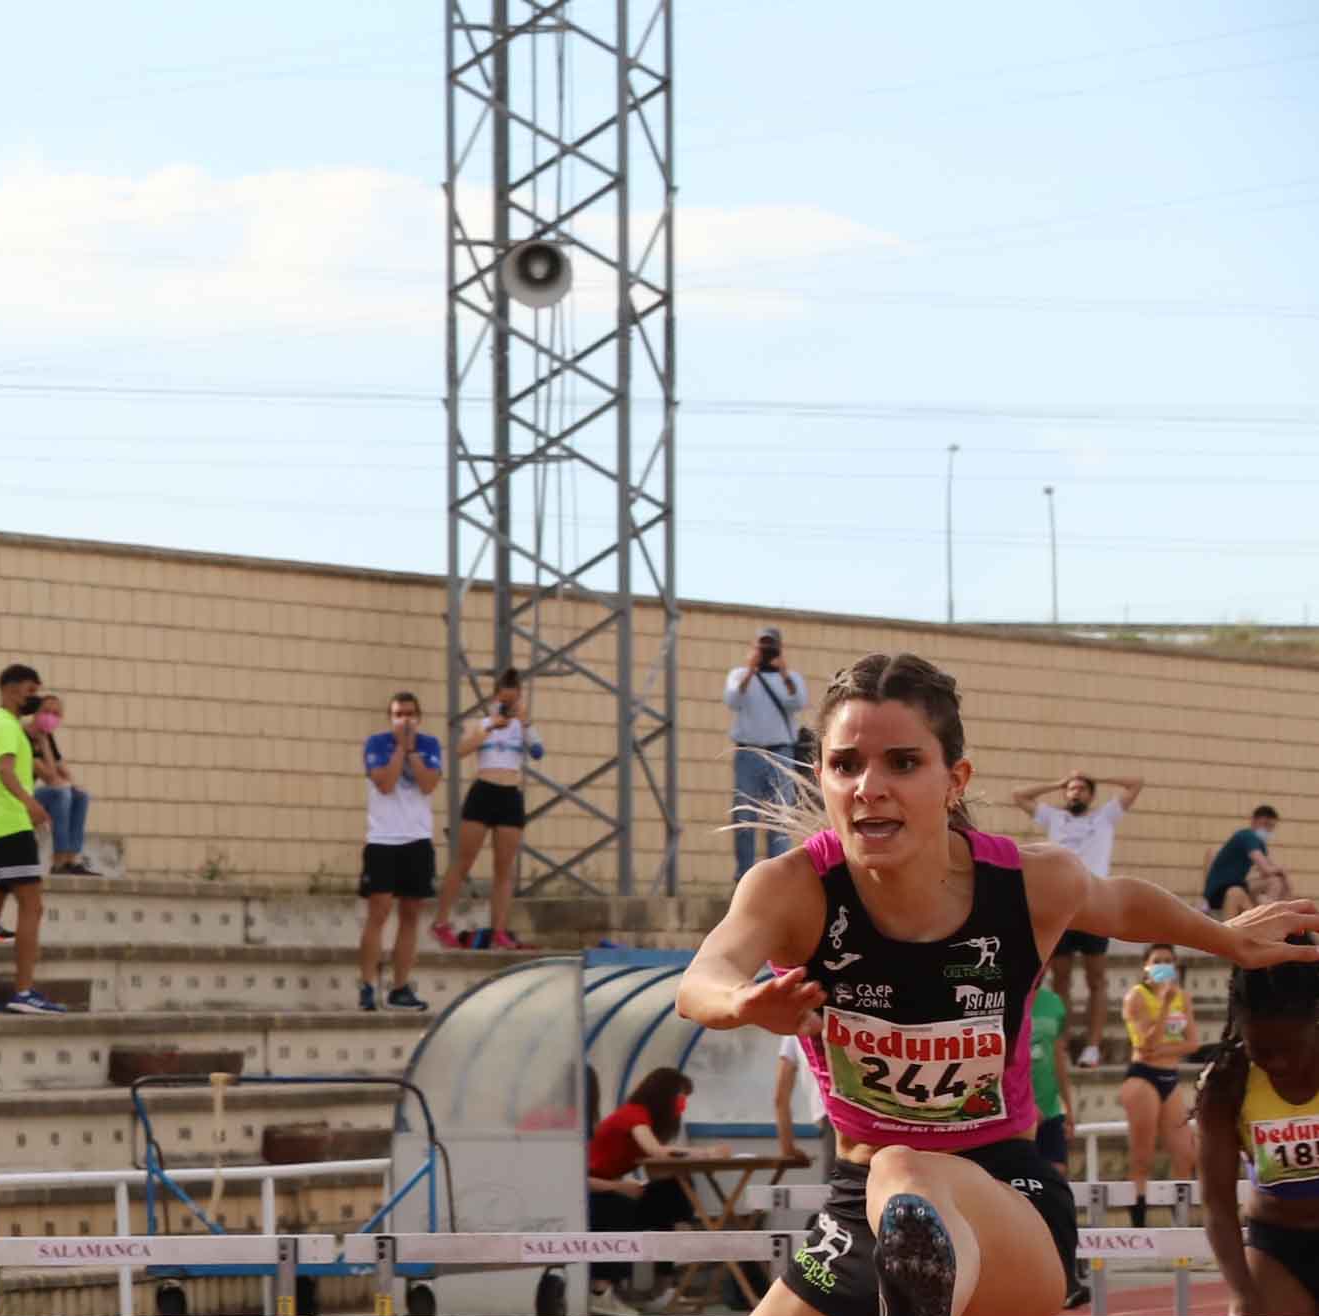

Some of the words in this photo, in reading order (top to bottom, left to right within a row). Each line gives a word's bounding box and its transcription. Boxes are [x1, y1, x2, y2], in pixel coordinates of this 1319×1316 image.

[827, 1014, 1003, 1062] bedunia
[860, 1057, 967, 1103] 244
[38, 1243, 152, 1259] SALAMANCA
[523, 1239, 639, 1254] SALAMANCA
